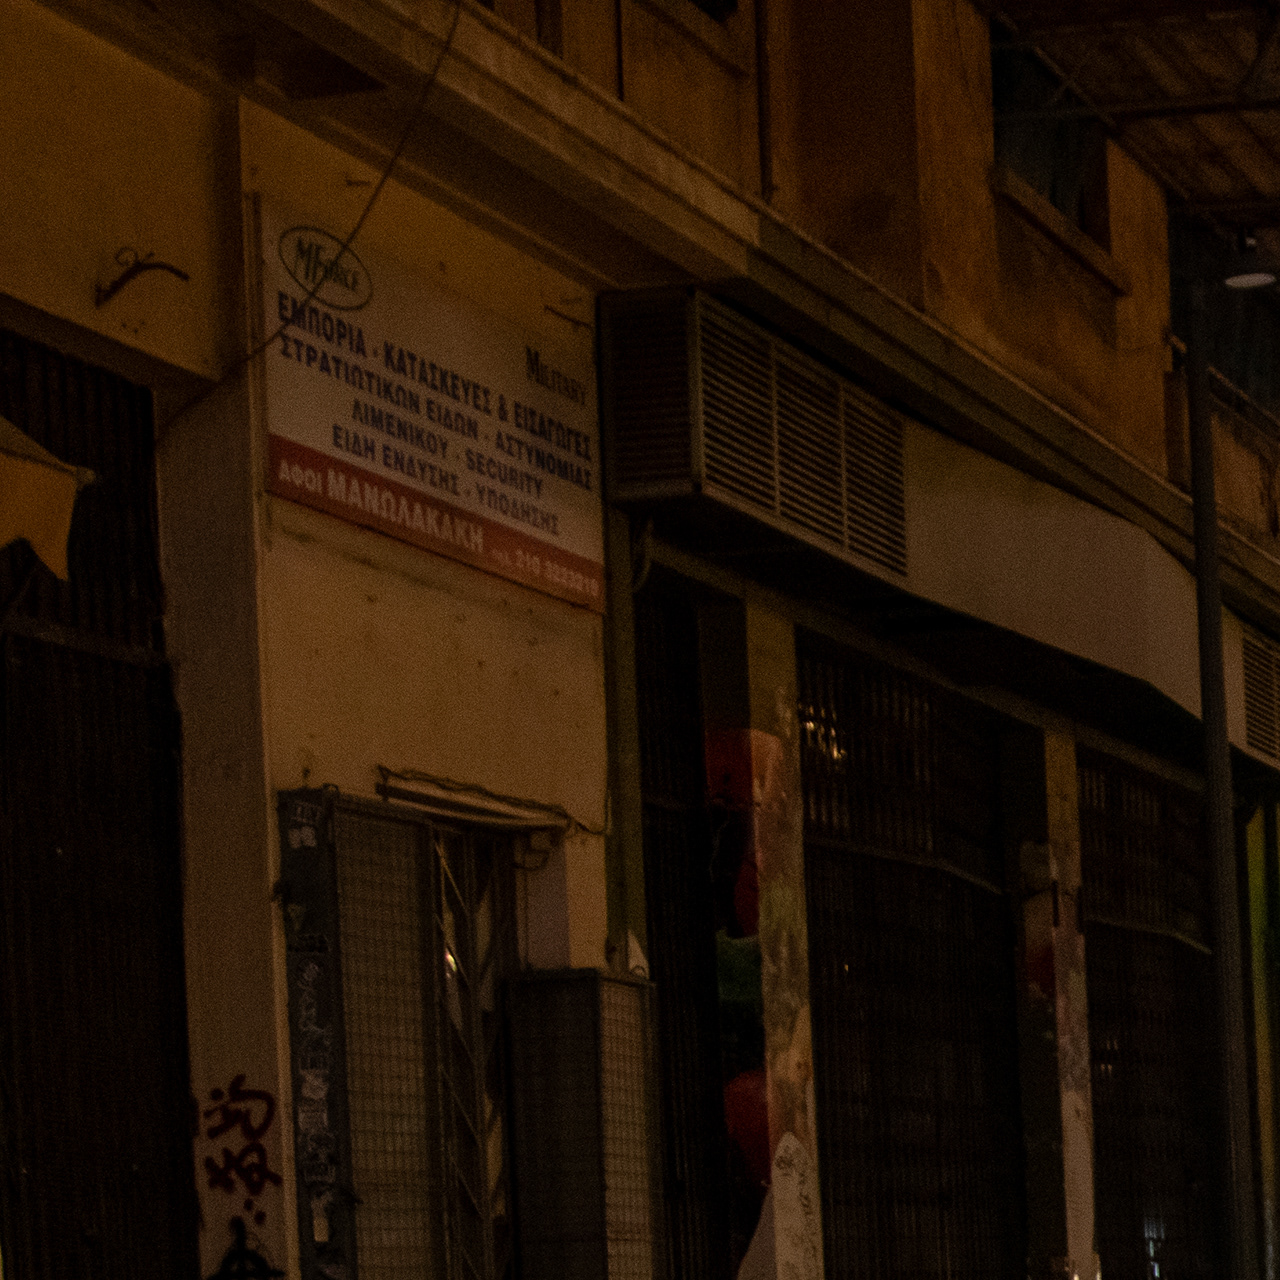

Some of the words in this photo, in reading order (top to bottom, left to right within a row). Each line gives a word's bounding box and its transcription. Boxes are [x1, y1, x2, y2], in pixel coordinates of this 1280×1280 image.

[277, 291, 367, 357] ΕΜΠΟΡΙΑ
[383, 340, 492, 413] ΚΑΤΑΣΚΕΥΕΣ
[514, 401, 592, 460] ΕΙΣΑΓΩΓΕΣ
[280, 333, 421, 415] ΣΤΡΑΤΙΩΤΙΚΩΝ
[426, 399, 479, 441] ΕΙΔΩΝ
[495, 430, 592, 491] ΑΣΤΥΝΟΜΙΑΣ
[332, 425, 376, 463] ΕΙΔΗ
[381, 447, 461, 496] ΕΝΔΥΣΗΣ
[476, 485, 560, 536] ΥΠΟΔΗΣΗΣ
[352, 400, 449, 460] ΛΙΜΕΝΙΚΟΥ
[465, 449, 544, 498] SECURITY
[279, 459, 324, 493] ΑΦΟΙ
[326, 467, 485, 557] ΜΑΝΩΛΑΚΑΚΗ
